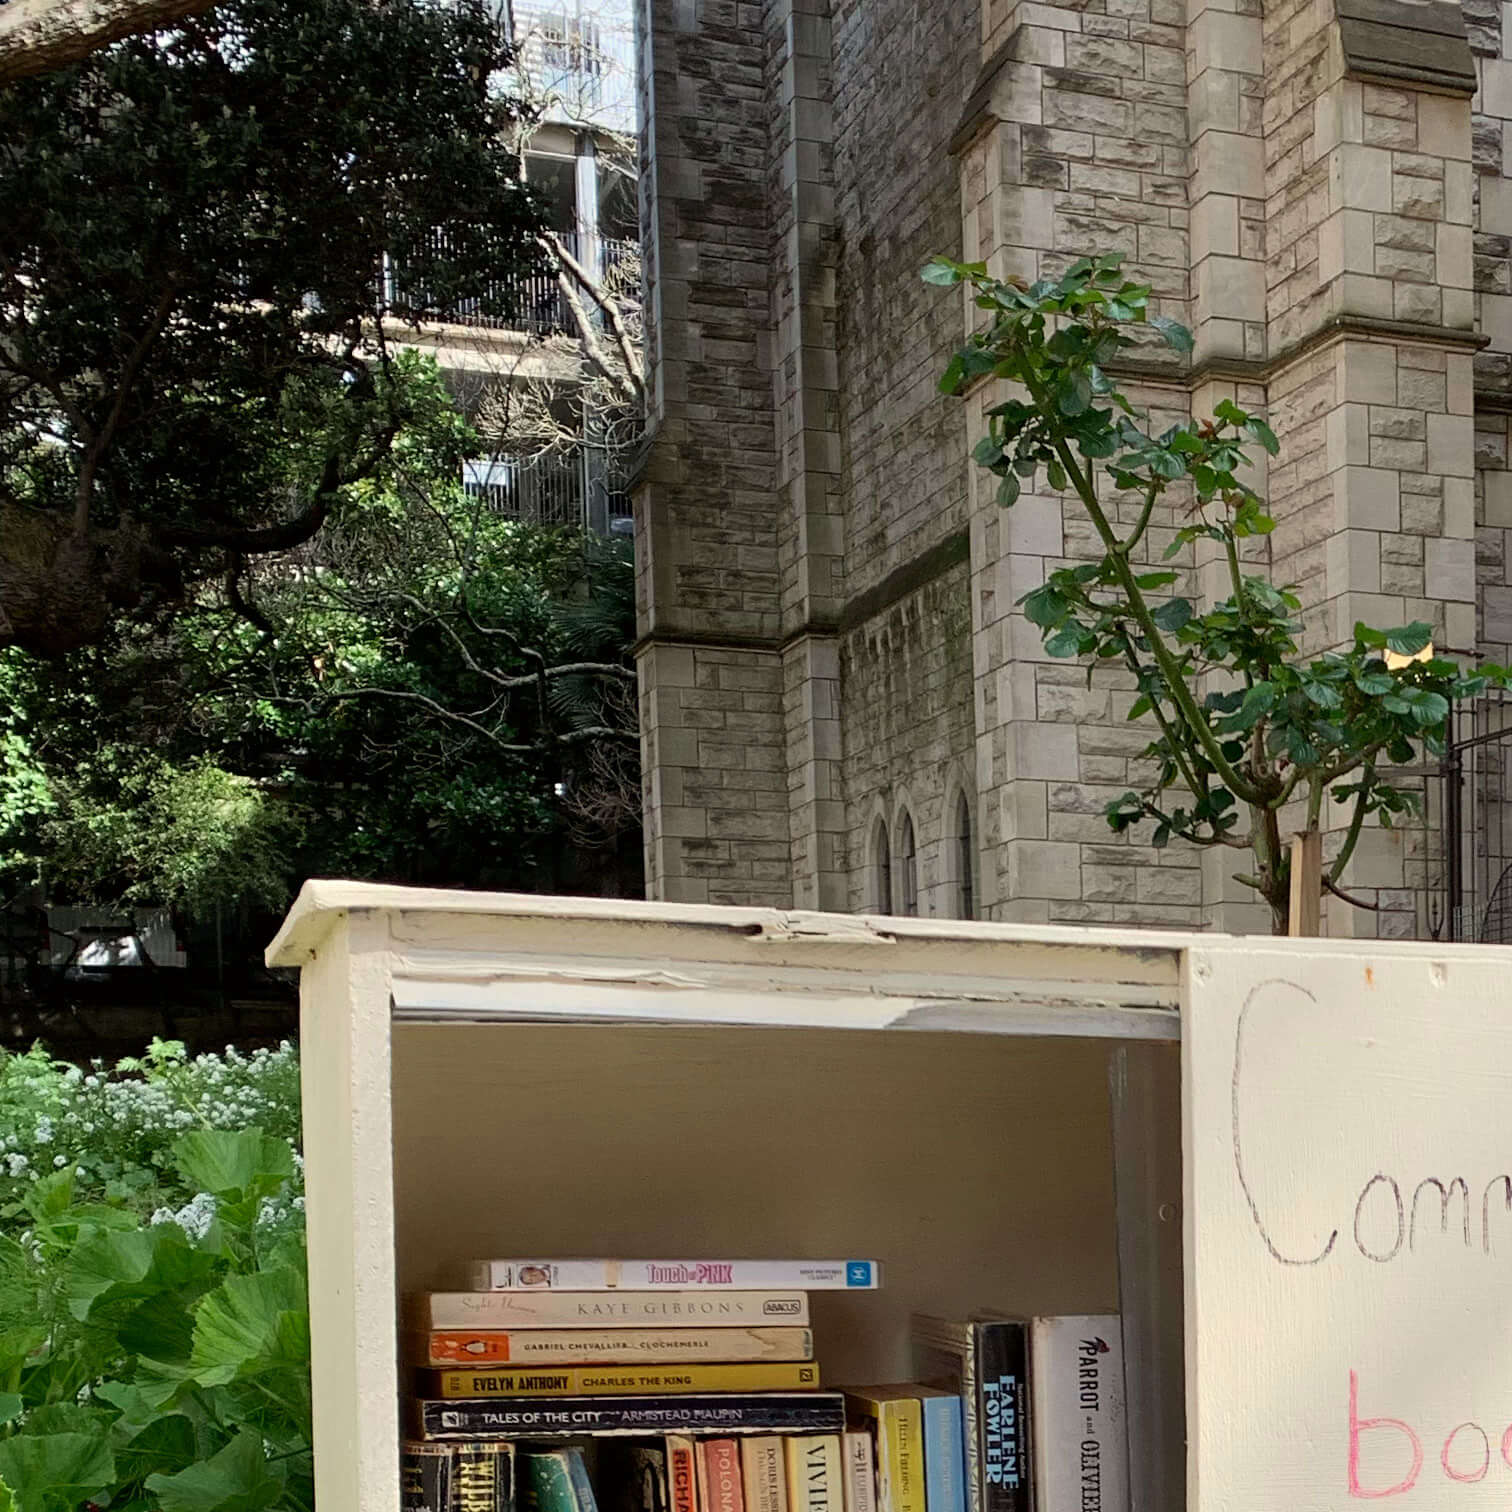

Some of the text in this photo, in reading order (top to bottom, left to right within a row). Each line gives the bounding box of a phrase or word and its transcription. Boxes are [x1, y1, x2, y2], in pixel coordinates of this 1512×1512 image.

[647, 1263, 688, 1283] Touch
[577, 1301, 745, 1314] KAYE GIBBONS
[765, 1302, 799, 1313] ABACUS
[473, 1377, 514, 1392] EVELYN
[517, 1375, 569, 1391] ANTHONY
[582, 1375, 693, 1387] CHARLES THE KING
[1079, 1344, 1100, 1412] PARROT
[482, 1412, 520, 1425] TALES
[522, 1411, 540, 1424] OF
[542, 1411, 568, 1423] THE
[571, 1411, 602, 1423] CITY
[621, 1408, 743, 1422] ARMISTEAD MAUPIN
[983, 1382, 1002, 1483] FOWLER
[999, 1375, 1019, 1489] EARLENE
[1086, 1416, 1095, 1435] and
[767, 1448, 778, 1482] DORIS
